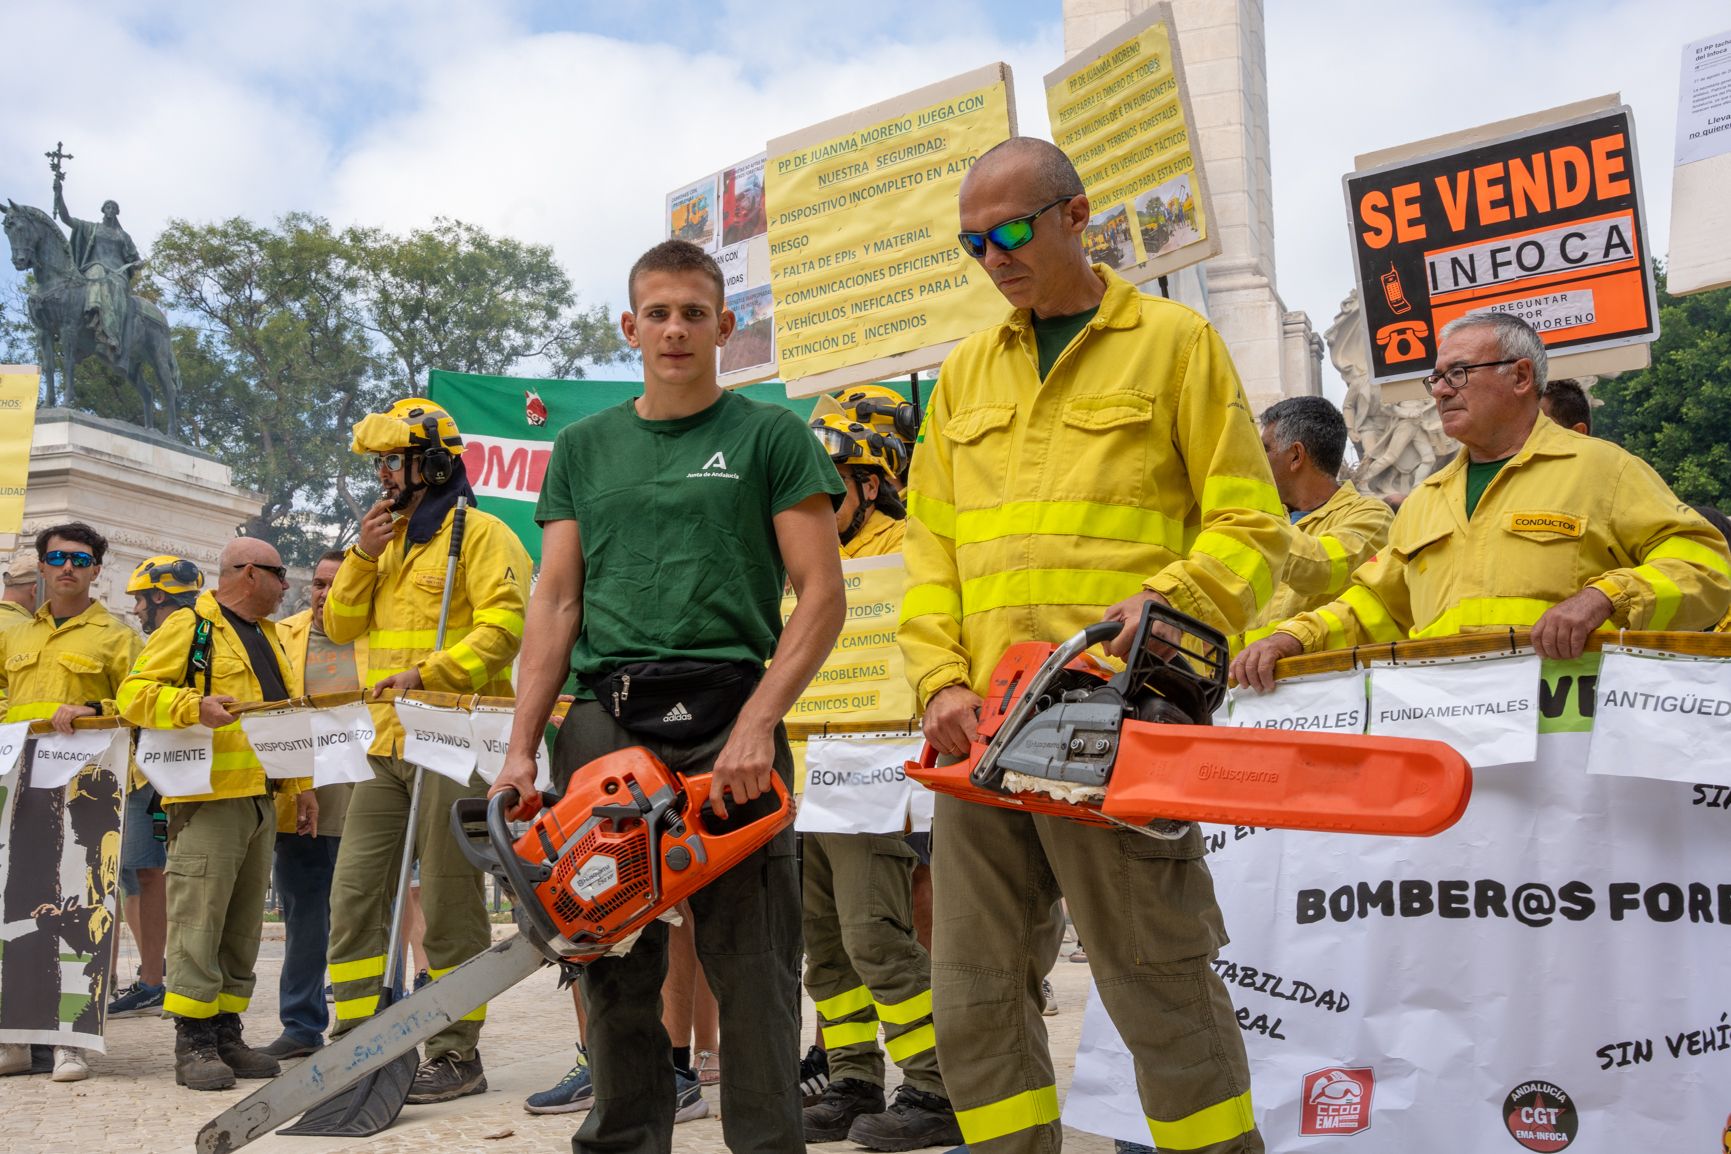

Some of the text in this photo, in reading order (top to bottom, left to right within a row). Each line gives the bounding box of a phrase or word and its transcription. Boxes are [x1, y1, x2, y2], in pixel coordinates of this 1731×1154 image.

[1111, 41, 1141, 66] MORENO
[1102, 77, 1126, 99] DINERO
[778, 160, 791, 173] PP
[794, 154, 808, 168] DE
[809, 138, 858, 163] JUANMA
[860, 119, 912, 144] MORENO
[917, 105, 955, 127] JUEGA
[957, 95, 985, 113] CON
[1081, 114, 1110, 138] MILLONES
[1106, 125, 1138, 150] TERRENOS
[1139, 104, 1178, 133] FORESTALES
[818, 137, 947, 187] NUESTRA SEGURIDAD:
[1157, 165, 1174, 180] ESTA
[1174, 156, 1192, 173] FOTO
[779, 155, 978, 225] DISPOSITIVO INCOMPLETO EN ALTO
[1359, 133, 1631, 250] SE VENDE
[771, 235, 809, 256] RIESGO
[783, 260, 816, 278] FALTA
[818, 255, 833, 269] DE
[863, 244, 872, 256] Y
[873, 227, 932, 255] MATERIAL
[724, 250, 739, 262] CON
[1428, 224, 1632, 292] INFOCA
[726, 274, 744, 286] VIDAS
[784, 271, 886, 305] COMUNICACIONES
[888, 247, 960, 278] DEFICIENTES
[786, 274, 969, 332] VEHÍCULOS INEFICACES PARA LA
[1491, 293, 1568, 313] PREGUNTAR
[1517, 309, 1542, 320] POR
[1532, 312, 1594, 331] MORENO
[781, 314, 927, 361] EXTINCIÓN DE INCENDIOS
[527, 409, 545, 425] CGT
[711, 472, 740, 480] Andalucía
[1515, 518, 1576, 532] CONDUCTOR
[849, 602, 896, 618] TOD@S:
[842, 631, 897, 649] CAMIONE
[815, 664, 886, 682] PROBLEMAS
[794, 694, 876, 713] TÉCNICOS QUE
[1380, 698, 1529, 723] FUNDAMENTALES
[1604, 690, 1731, 717] ANTIGÜED
[662, 713, 693, 722] adidas
[254, 737, 313, 752] DISPOSITIV
[414, 728, 471, 749] ESTAMOS
[37, 750, 96, 761] DE VACACIO
[143, 748, 207, 764] PP MIENTE
[1211, 765, 1280, 783] Husqvarna
[1296, 880, 1595, 928] BOMBER@S
[1596, 1012, 1731, 1070] SIN VEHÍ
[1511, 1082, 1567, 1103] ANDALUCÍA
[1317, 1104, 1361, 1115] CCOO
[1520, 1106, 1559, 1125] CGT
[1315, 1115, 1340, 1129] EMA
[1515, 1129, 1569, 1142] EMA-INFOCA
